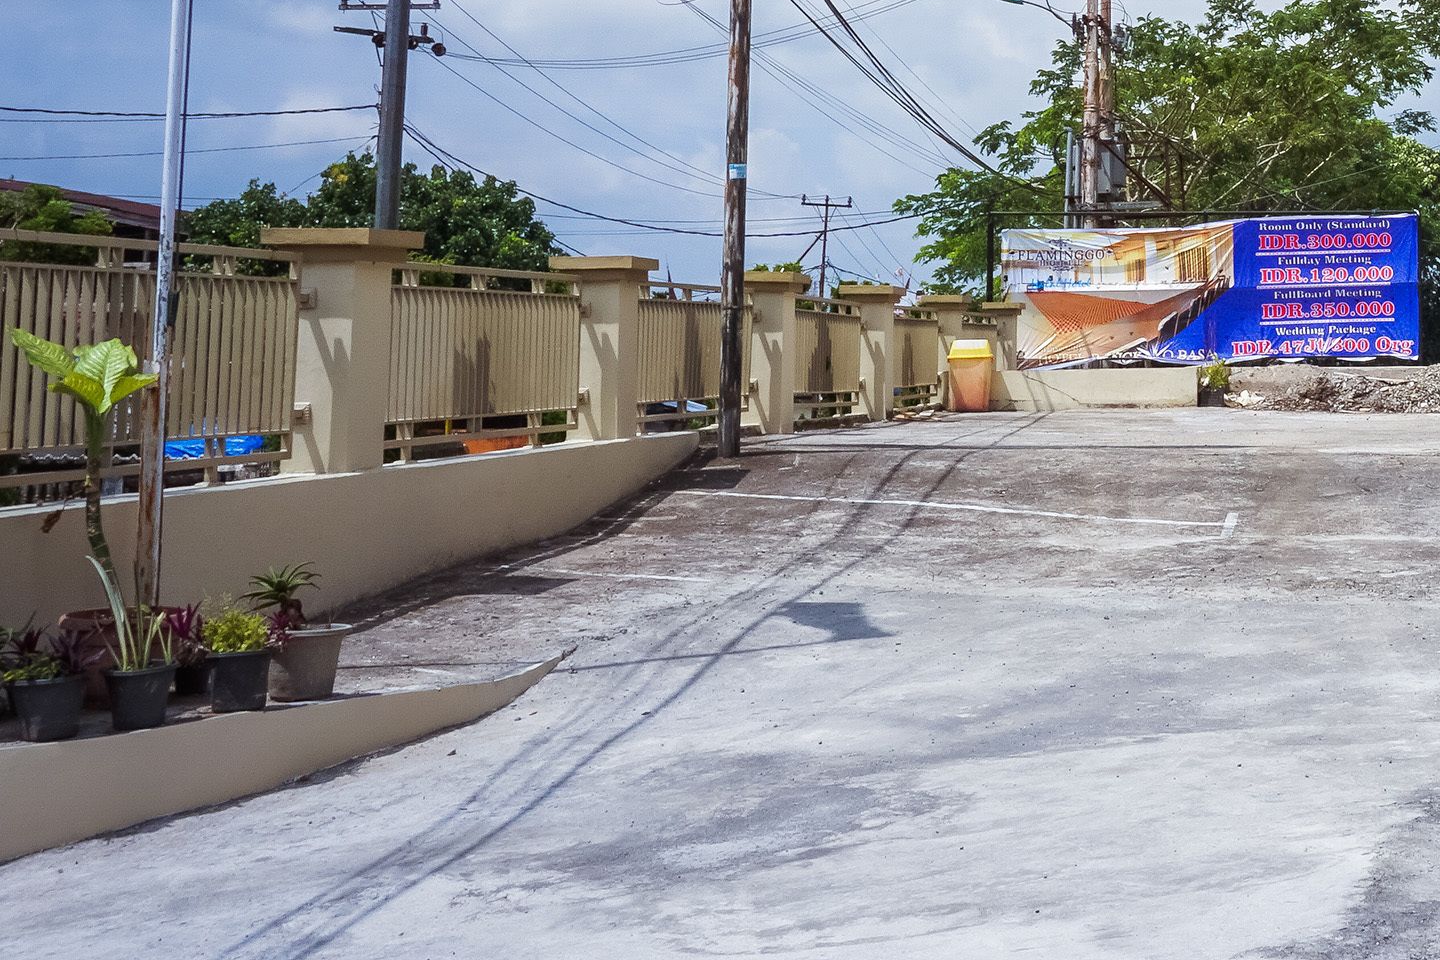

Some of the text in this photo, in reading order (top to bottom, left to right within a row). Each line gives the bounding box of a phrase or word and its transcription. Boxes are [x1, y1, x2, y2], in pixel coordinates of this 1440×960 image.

[1259, 220, 1390, 231] Room Only (Standard)
[1258, 232, 1393, 250] IDR.300.000
[1018, 248, 1105, 261] FLAMINGGO
[1278, 255, 1372, 266] Fullday Meeting
[1260, 266, 1394, 284] IDR.120.000
[1274, 289, 1382, 300] FullBoard Meeting
[1261, 301, 1395, 320] IDR.350.000
[1275, 325, 1376, 337] Wedding Package
[1375, 335, 1415, 356] Org
